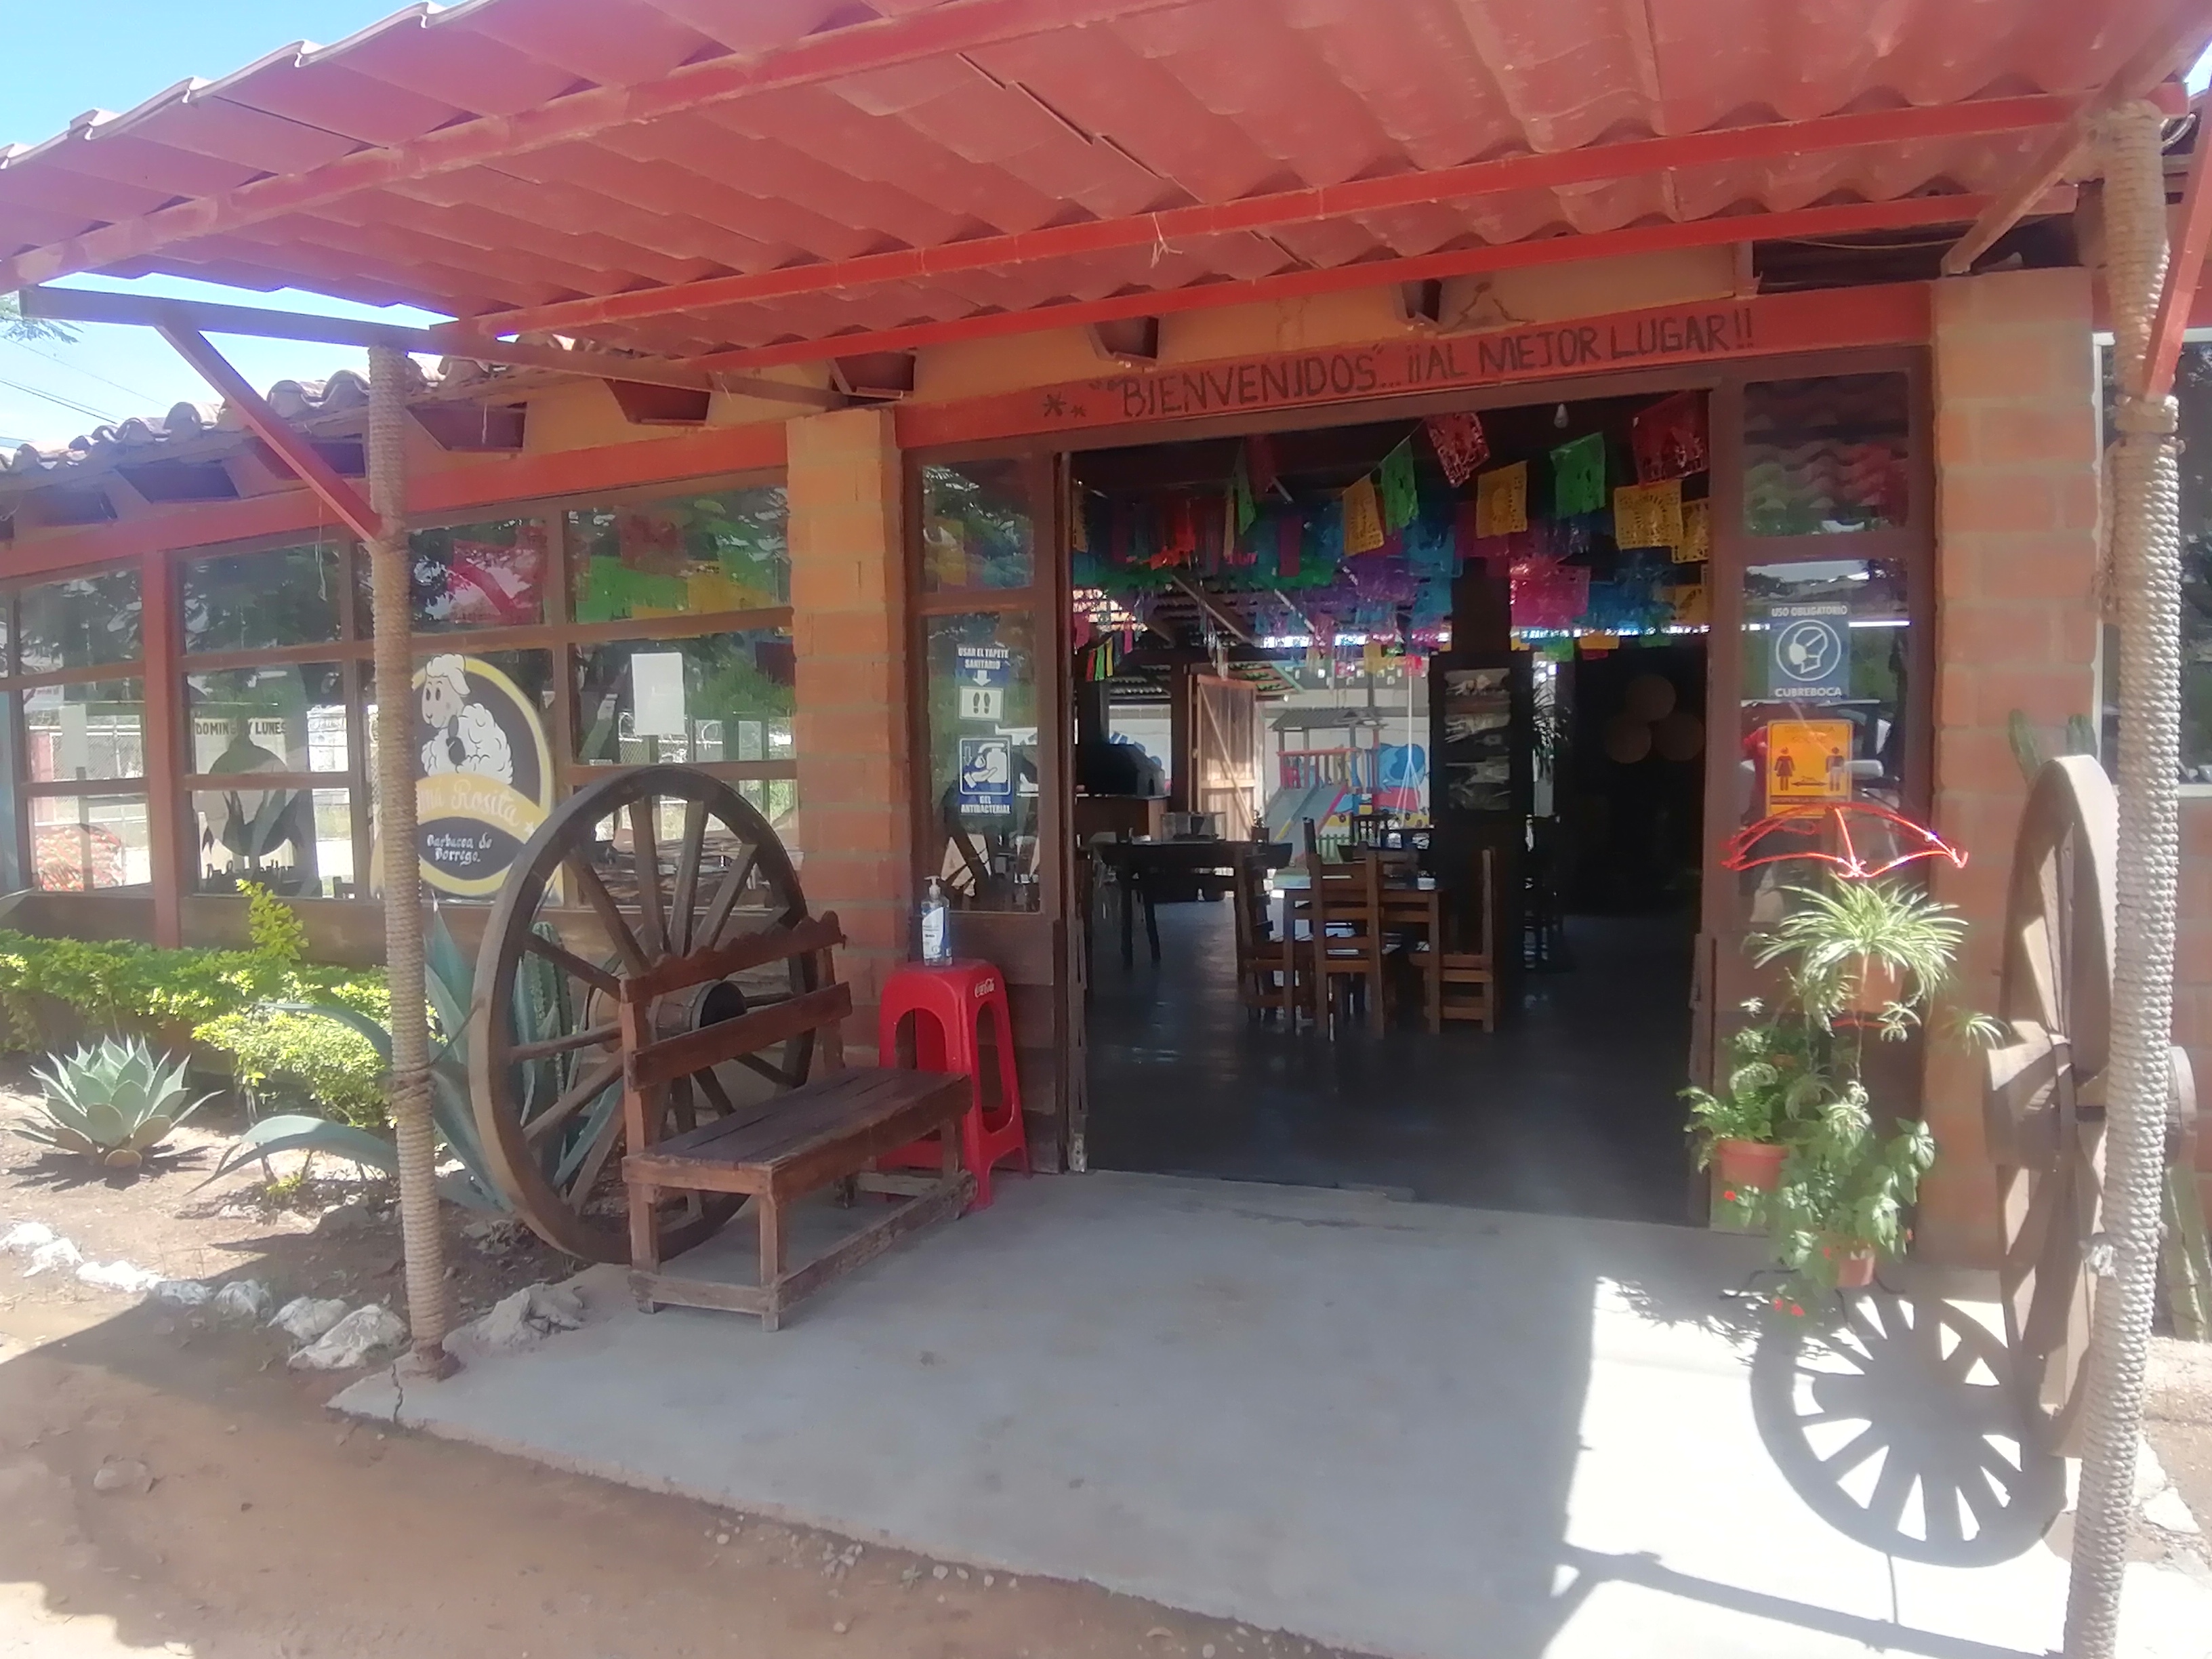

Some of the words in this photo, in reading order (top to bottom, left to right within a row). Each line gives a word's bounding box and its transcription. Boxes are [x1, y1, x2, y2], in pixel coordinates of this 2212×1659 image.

[1478, 325, 1602, 373] MEJOR
[1610, 308, 1754, 359] LUGAR!!
[1771, 607, 1789, 617] USO
[1790, 605, 1848, 617] OBLIGATORIO
[958, 647, 976, 657] USAR
[977, 647, 985, 657] EL
[964, 658, 1001, 670] SANITARIO
[1774, 687, 1843, 697] CUBREBOCA
[451, 779, 520, 827] Rosita
[960, 804, 1011, 815] ANTIBACTERIAL
[478, 832, 493, 849] de
